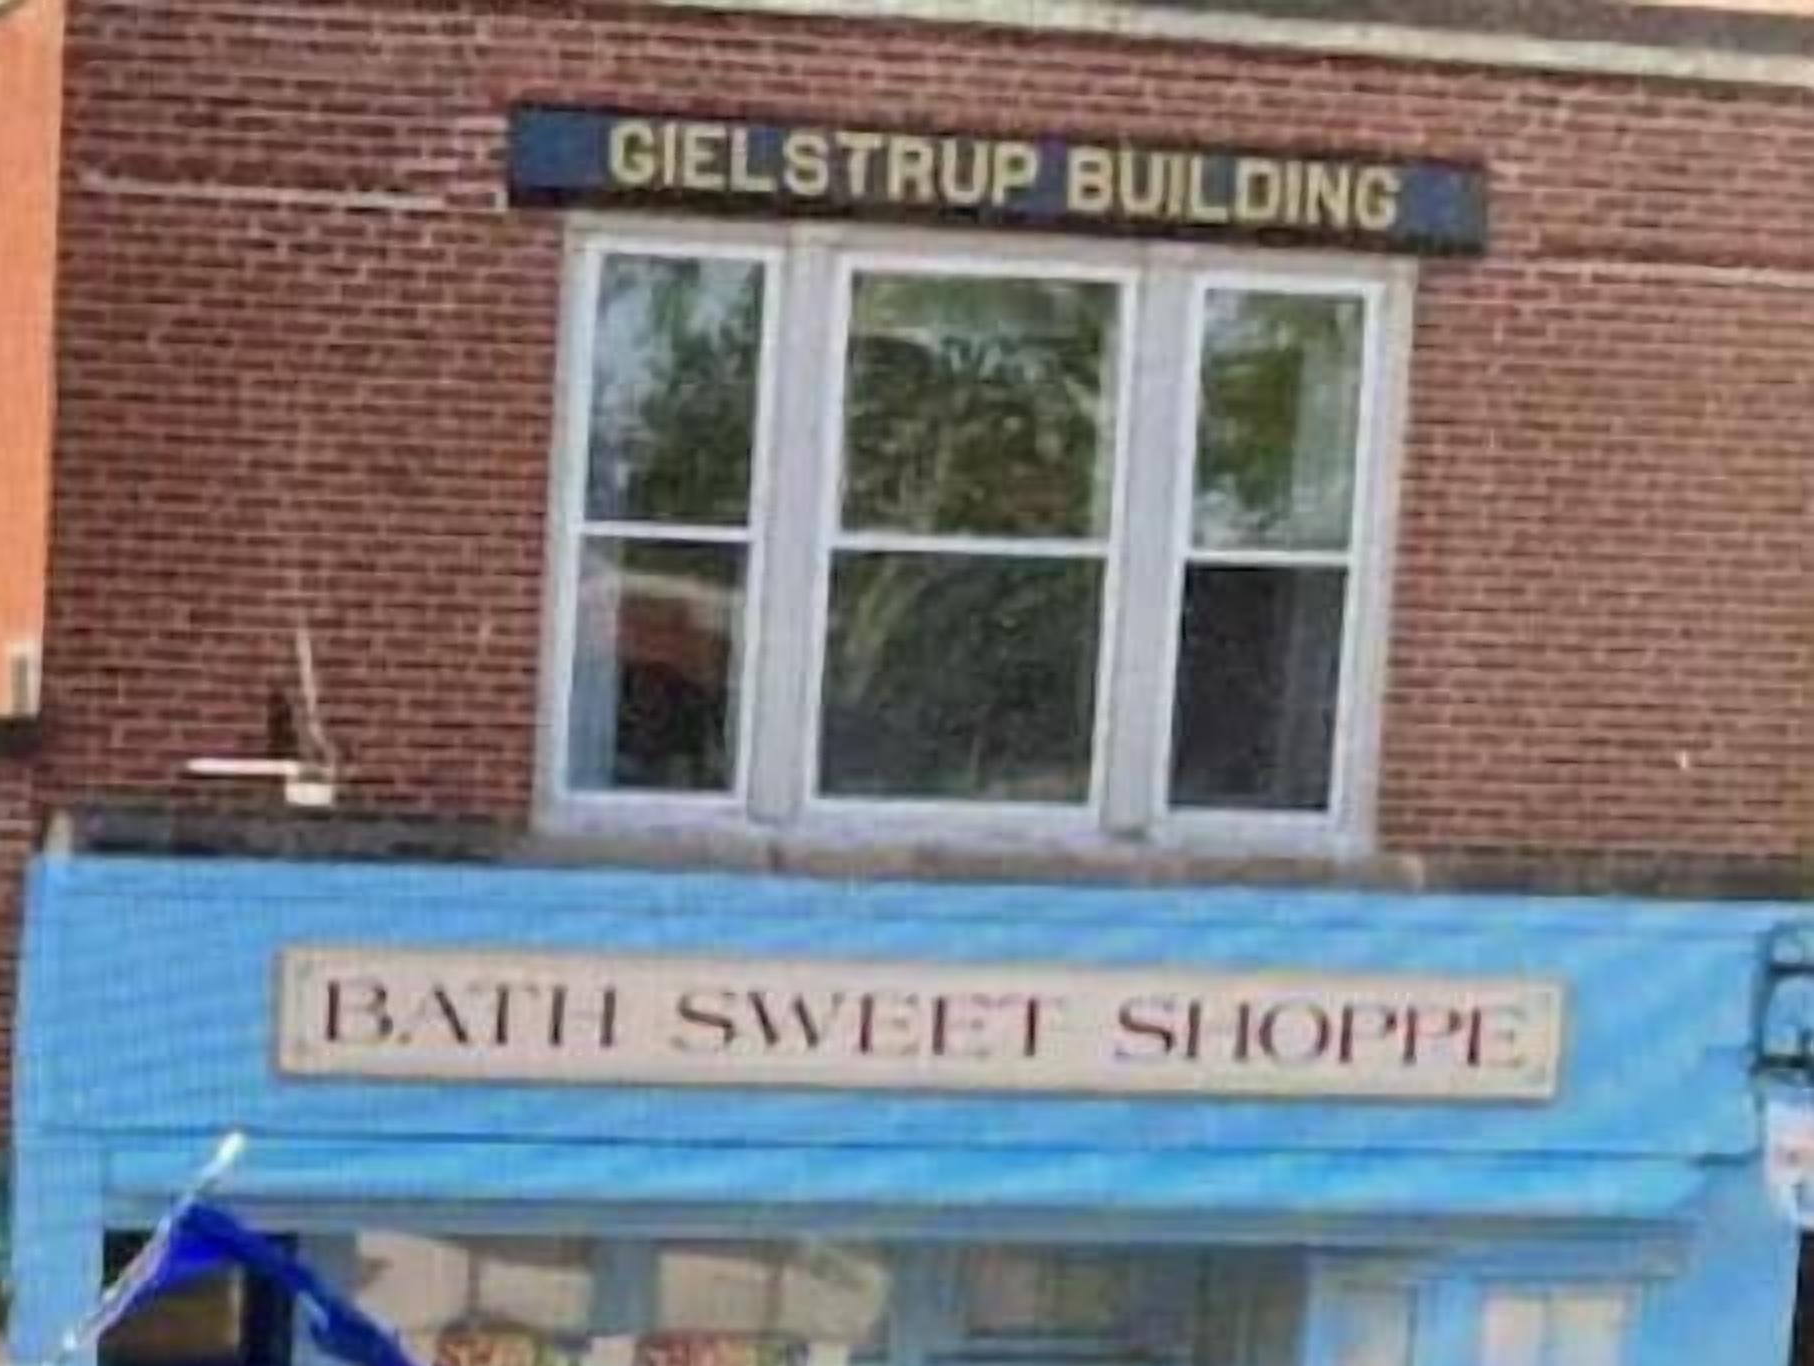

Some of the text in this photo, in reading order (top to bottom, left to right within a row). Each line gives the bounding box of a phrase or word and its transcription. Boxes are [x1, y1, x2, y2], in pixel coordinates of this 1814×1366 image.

[607, 119, 1401, 231] GIELSTRUP BUILDING
[322, 980, 1527, 1070] BATH SWEET SHOPPE
